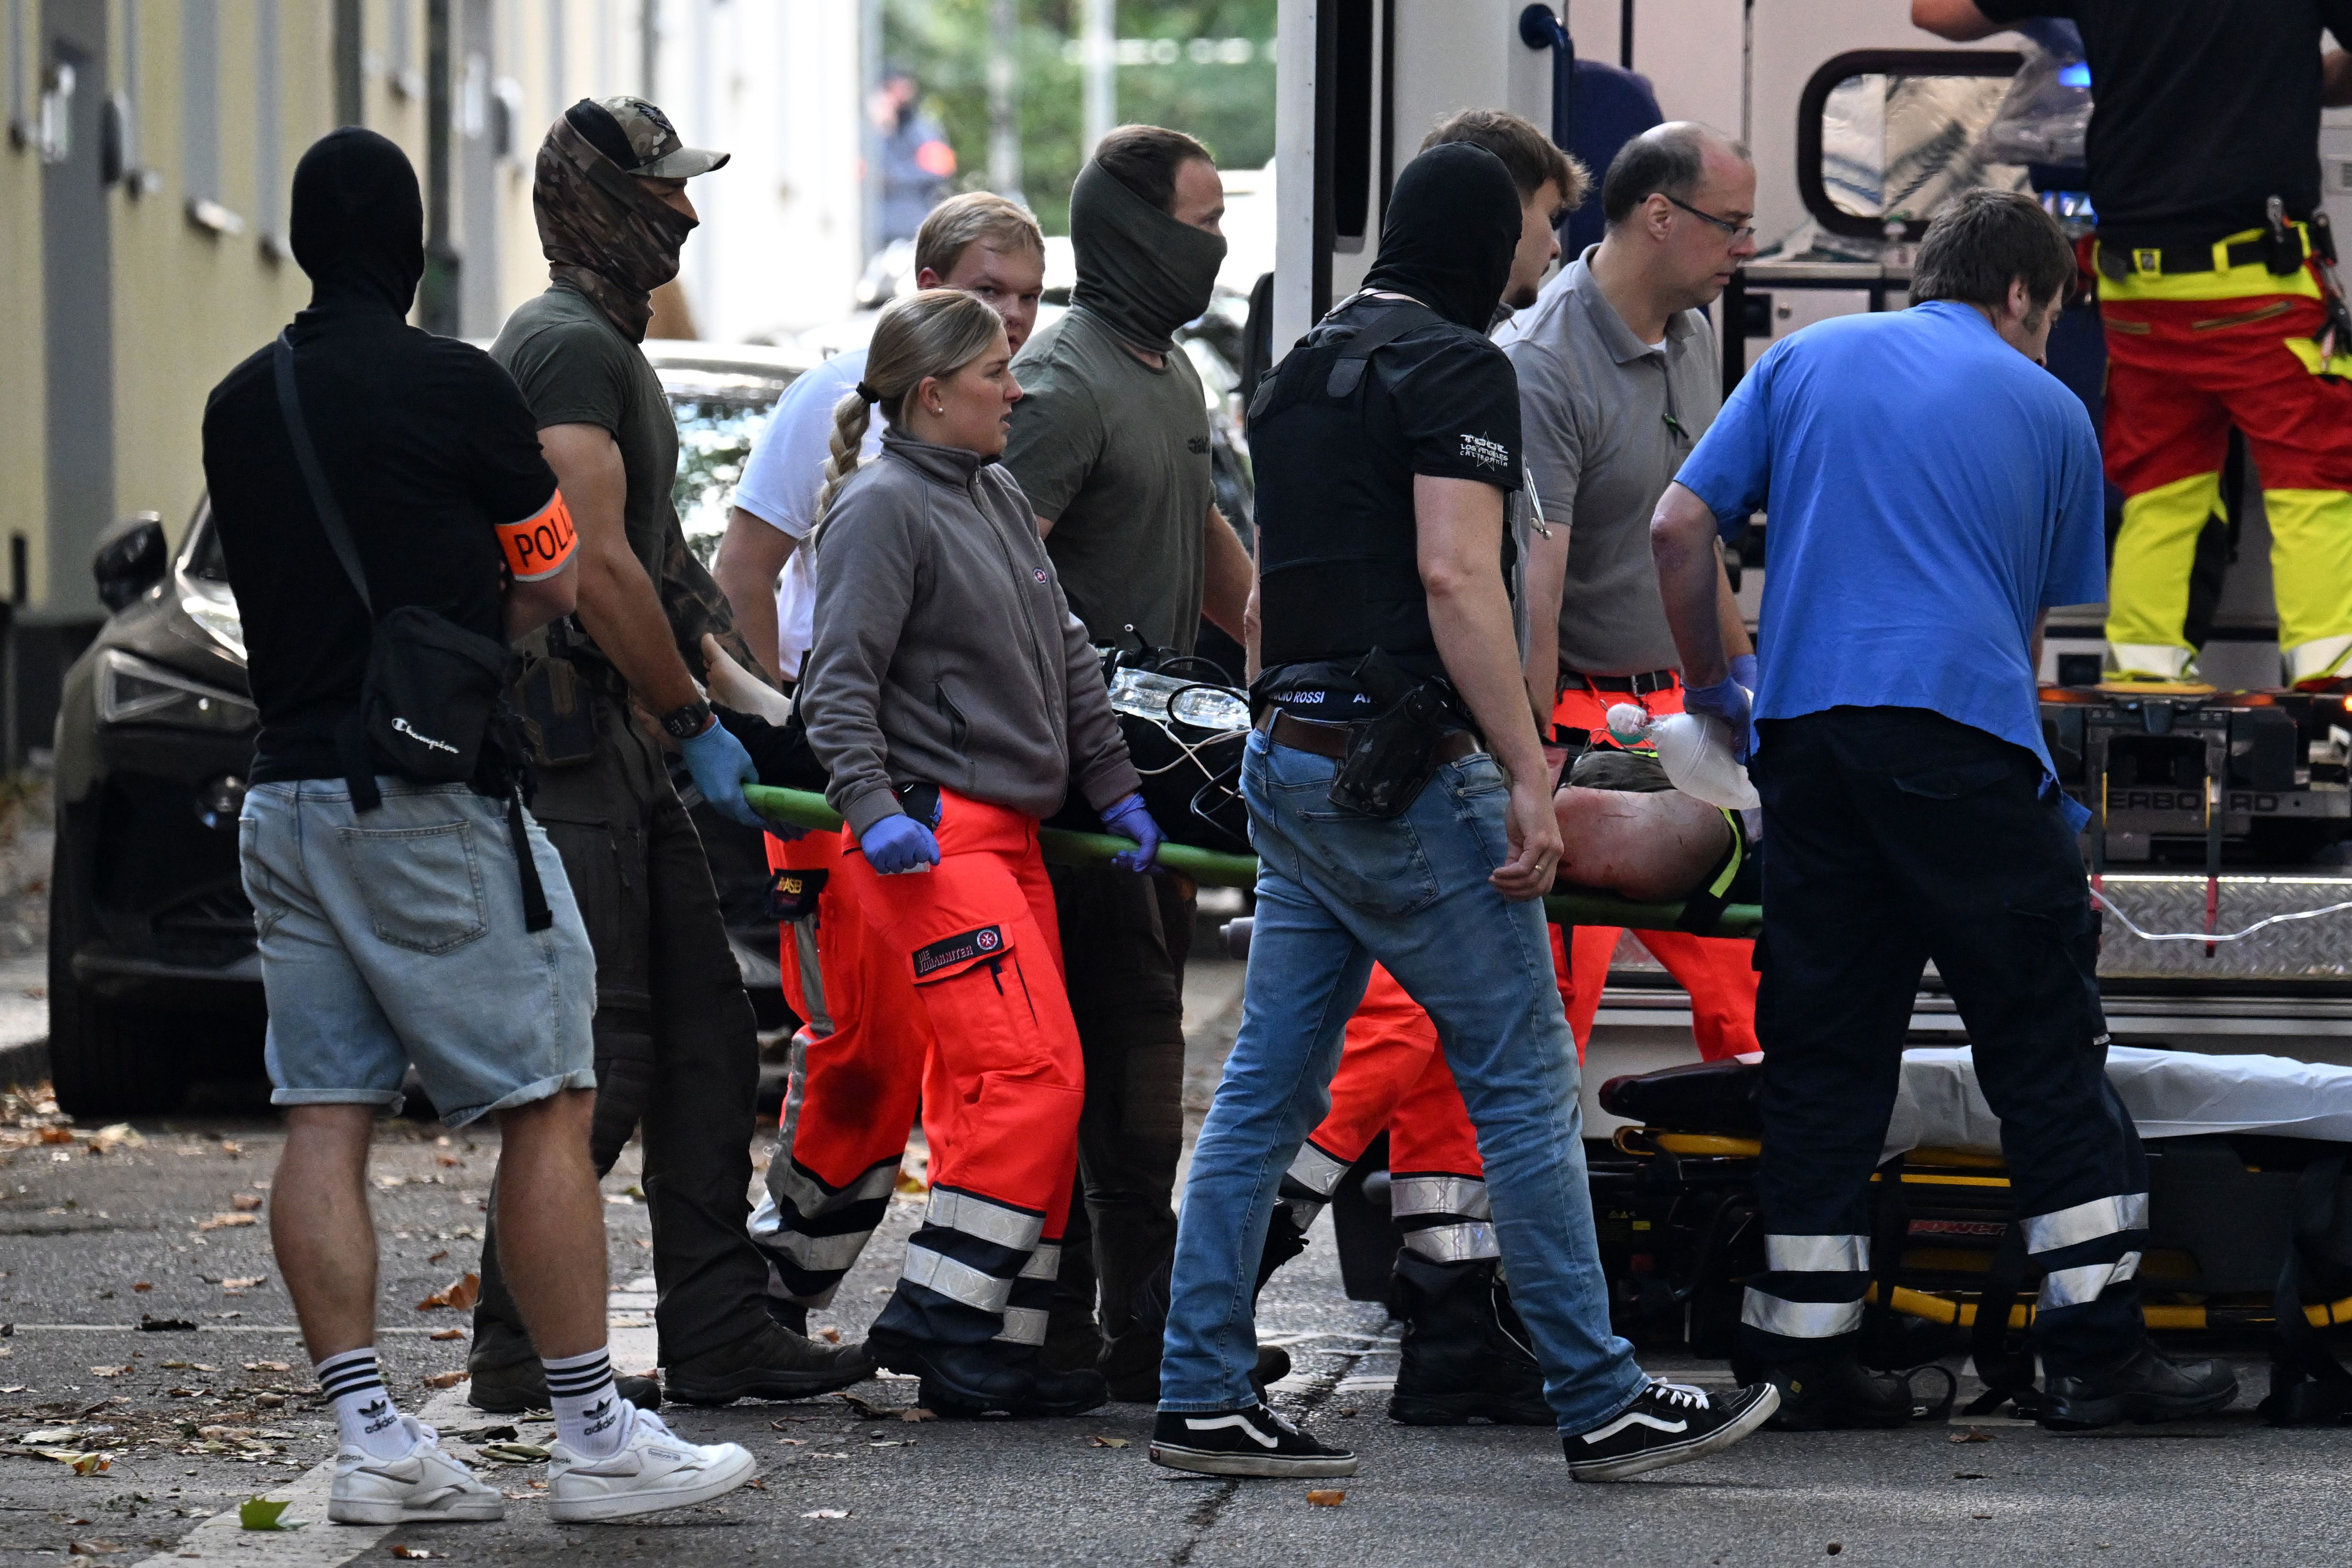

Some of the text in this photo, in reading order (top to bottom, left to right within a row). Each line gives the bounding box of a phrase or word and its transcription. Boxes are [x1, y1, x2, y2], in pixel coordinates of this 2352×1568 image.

[1478, 447, 1508, 461] ANGELES
[514, 506, 573, 568] POLI
[1293, 691, 1326, 704] ROSSI
[391, 717, 460, 754] Champion
[919, 950, 931, 962] DIE
[919, 945, 973, 973] JOHANNITER
[365, 1415, 398, 1434] adidas
